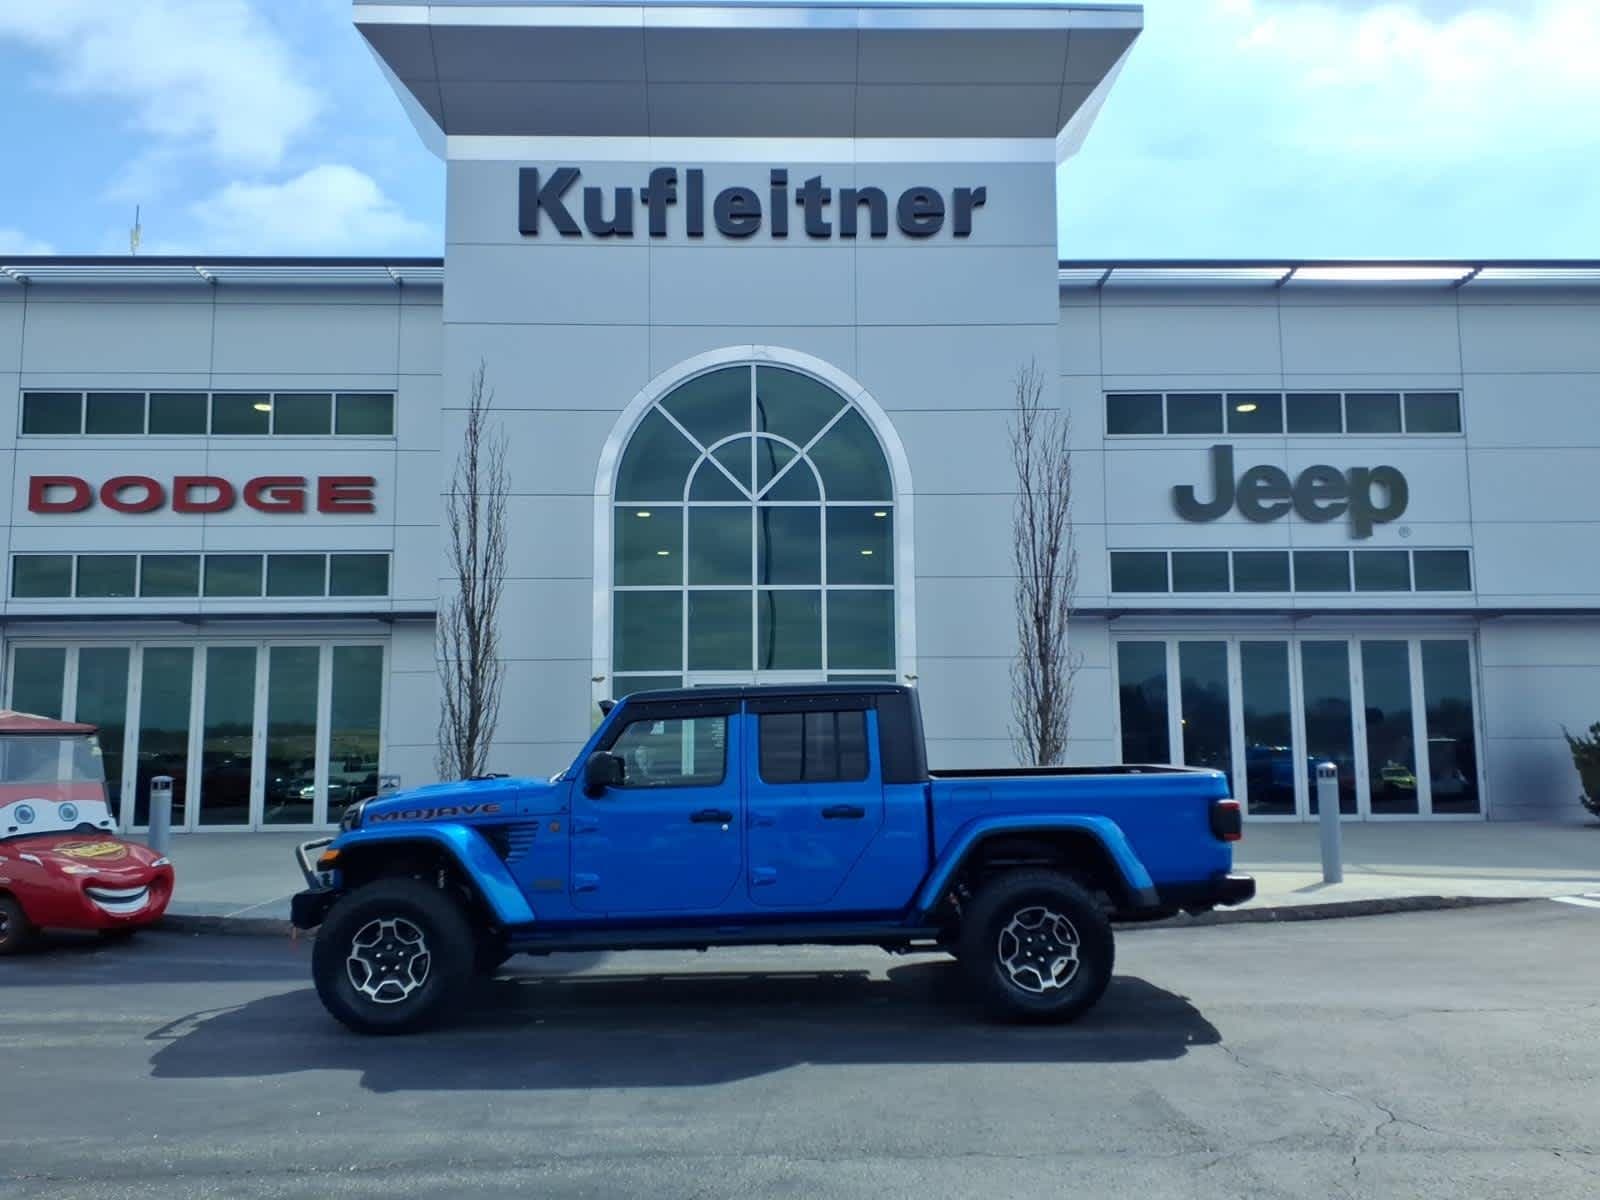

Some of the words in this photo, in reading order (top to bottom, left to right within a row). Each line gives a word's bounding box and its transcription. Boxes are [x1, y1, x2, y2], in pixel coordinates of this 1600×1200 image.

[518, 167, 987, 239] Kufleitner
[28, 475, 376, 514] DODGE
[1172, 444, 1409, 540] Jeep
[369, 803, 501, 822] MOJAVE
